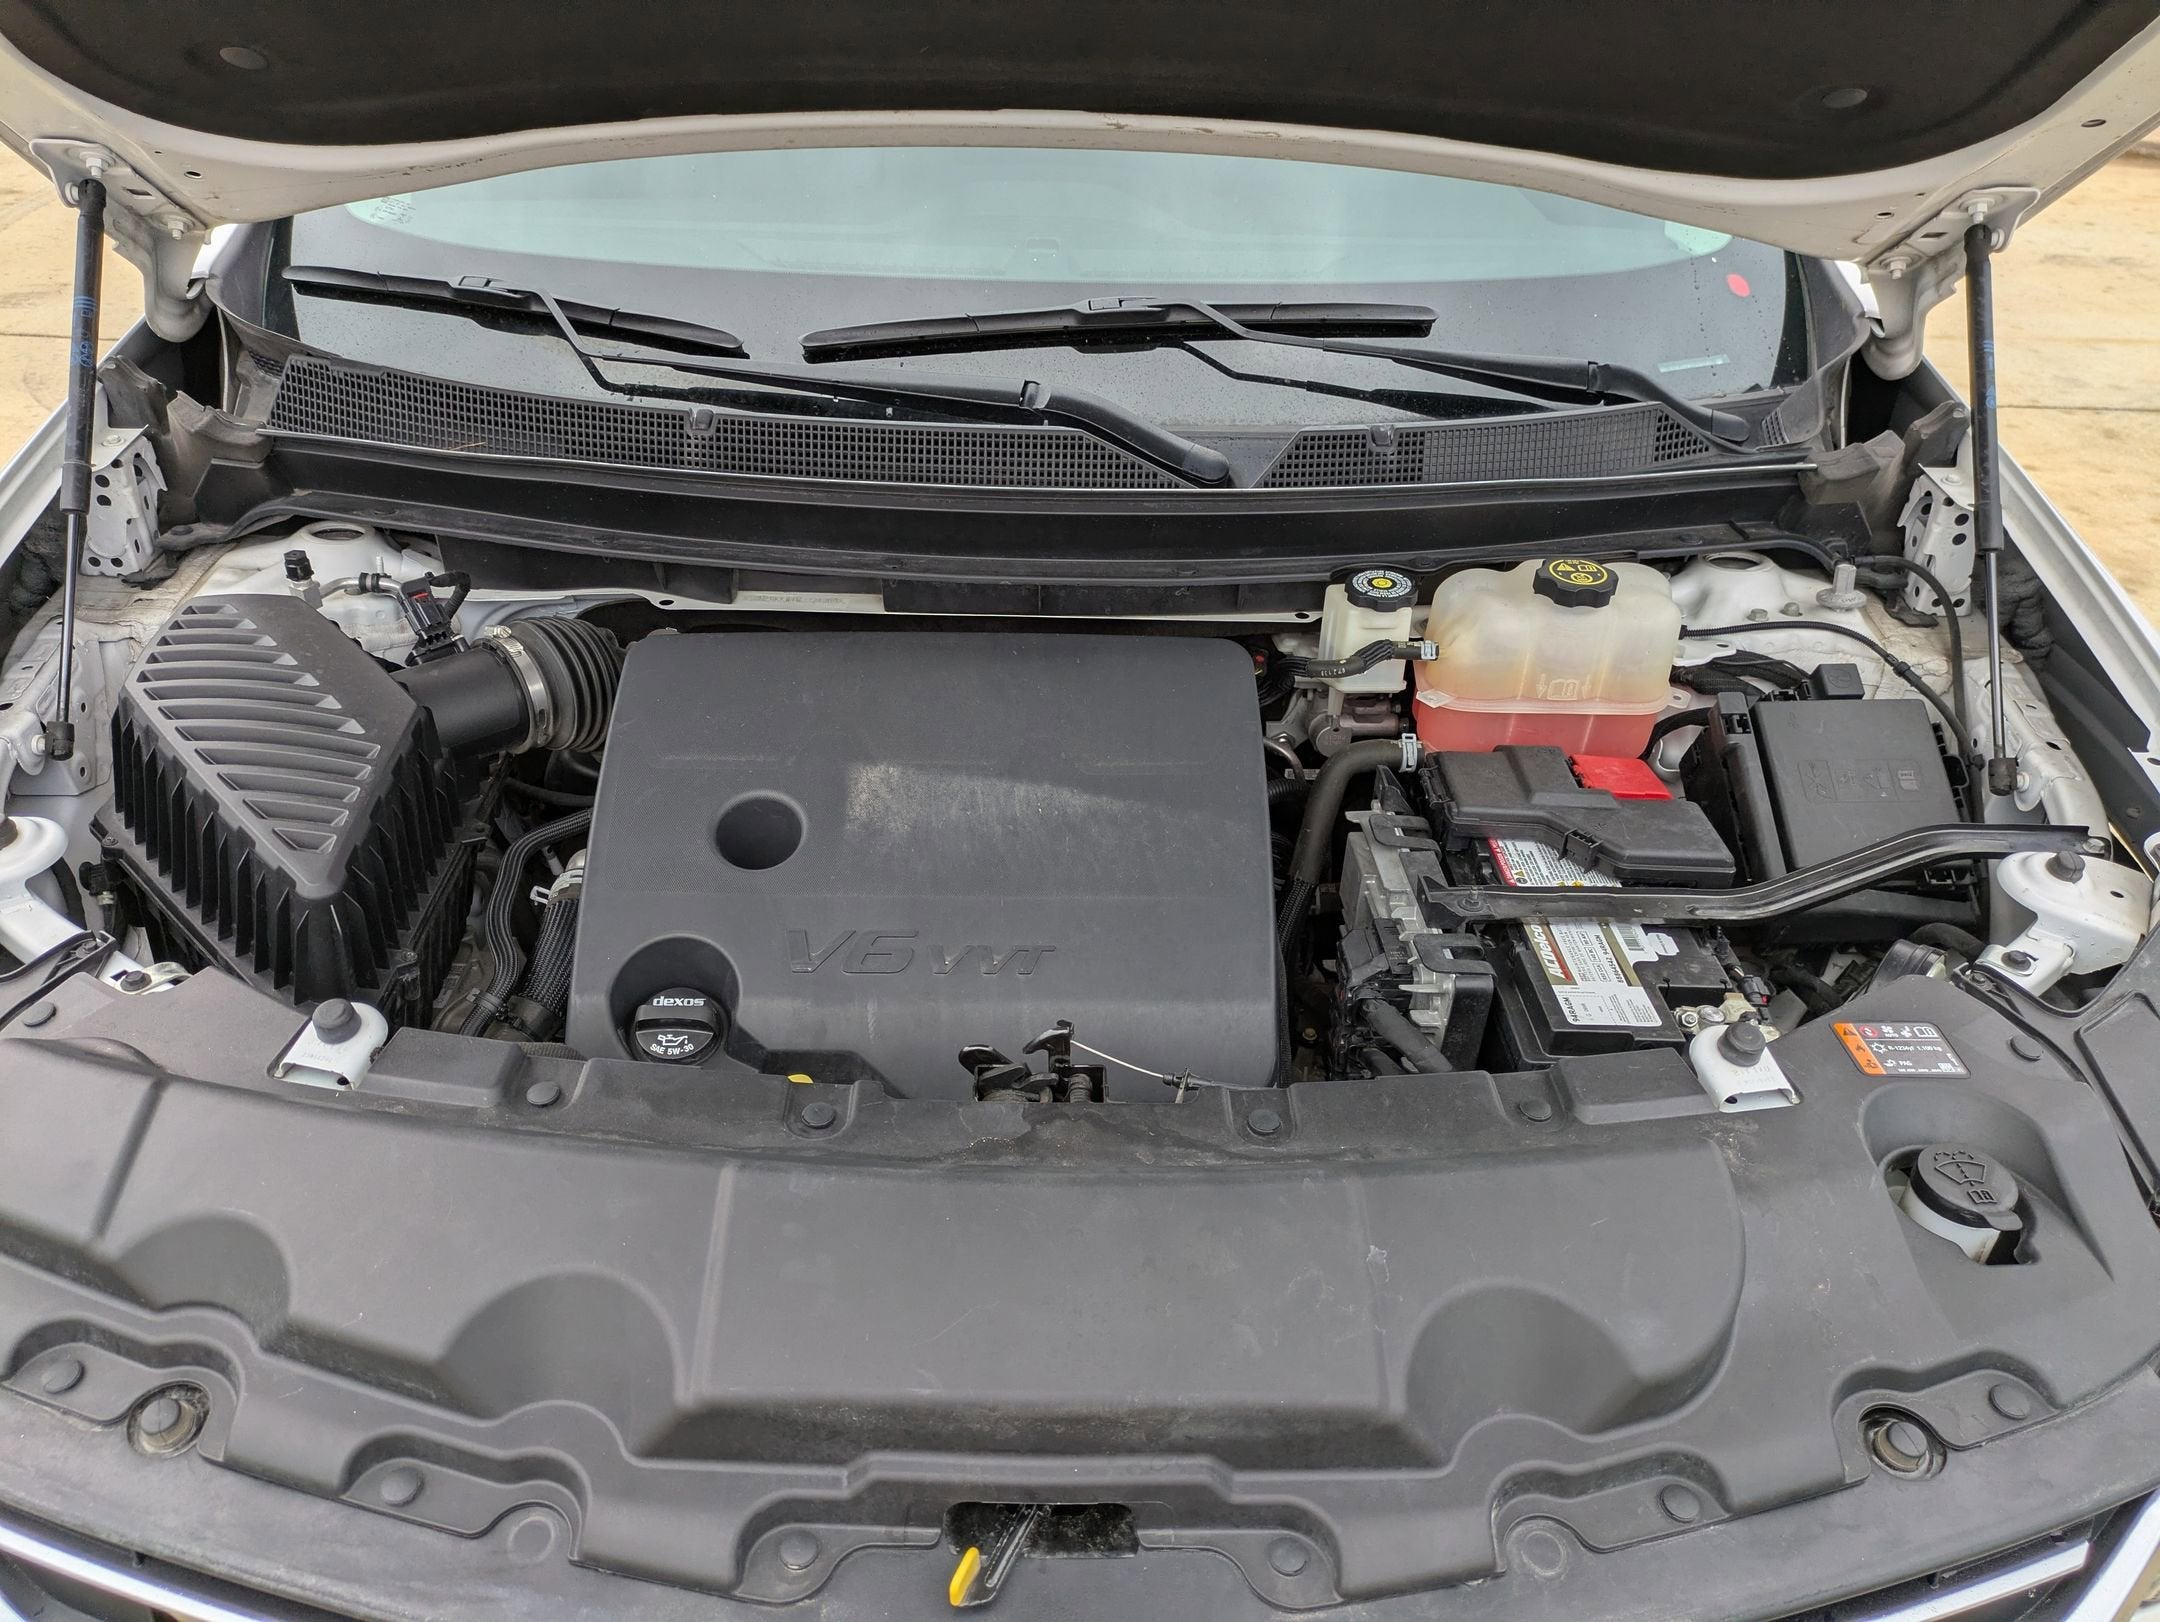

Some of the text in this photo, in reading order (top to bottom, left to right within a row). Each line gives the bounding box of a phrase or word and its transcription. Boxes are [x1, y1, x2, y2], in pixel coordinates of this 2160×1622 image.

[786, 929, 1057, 975] V6 VVT
[1530, 924, 1566, 979] ACDelco
[652, 996, 706, 1007] dexos
[650, 1043, 694, 1055] SAE 5W-30
